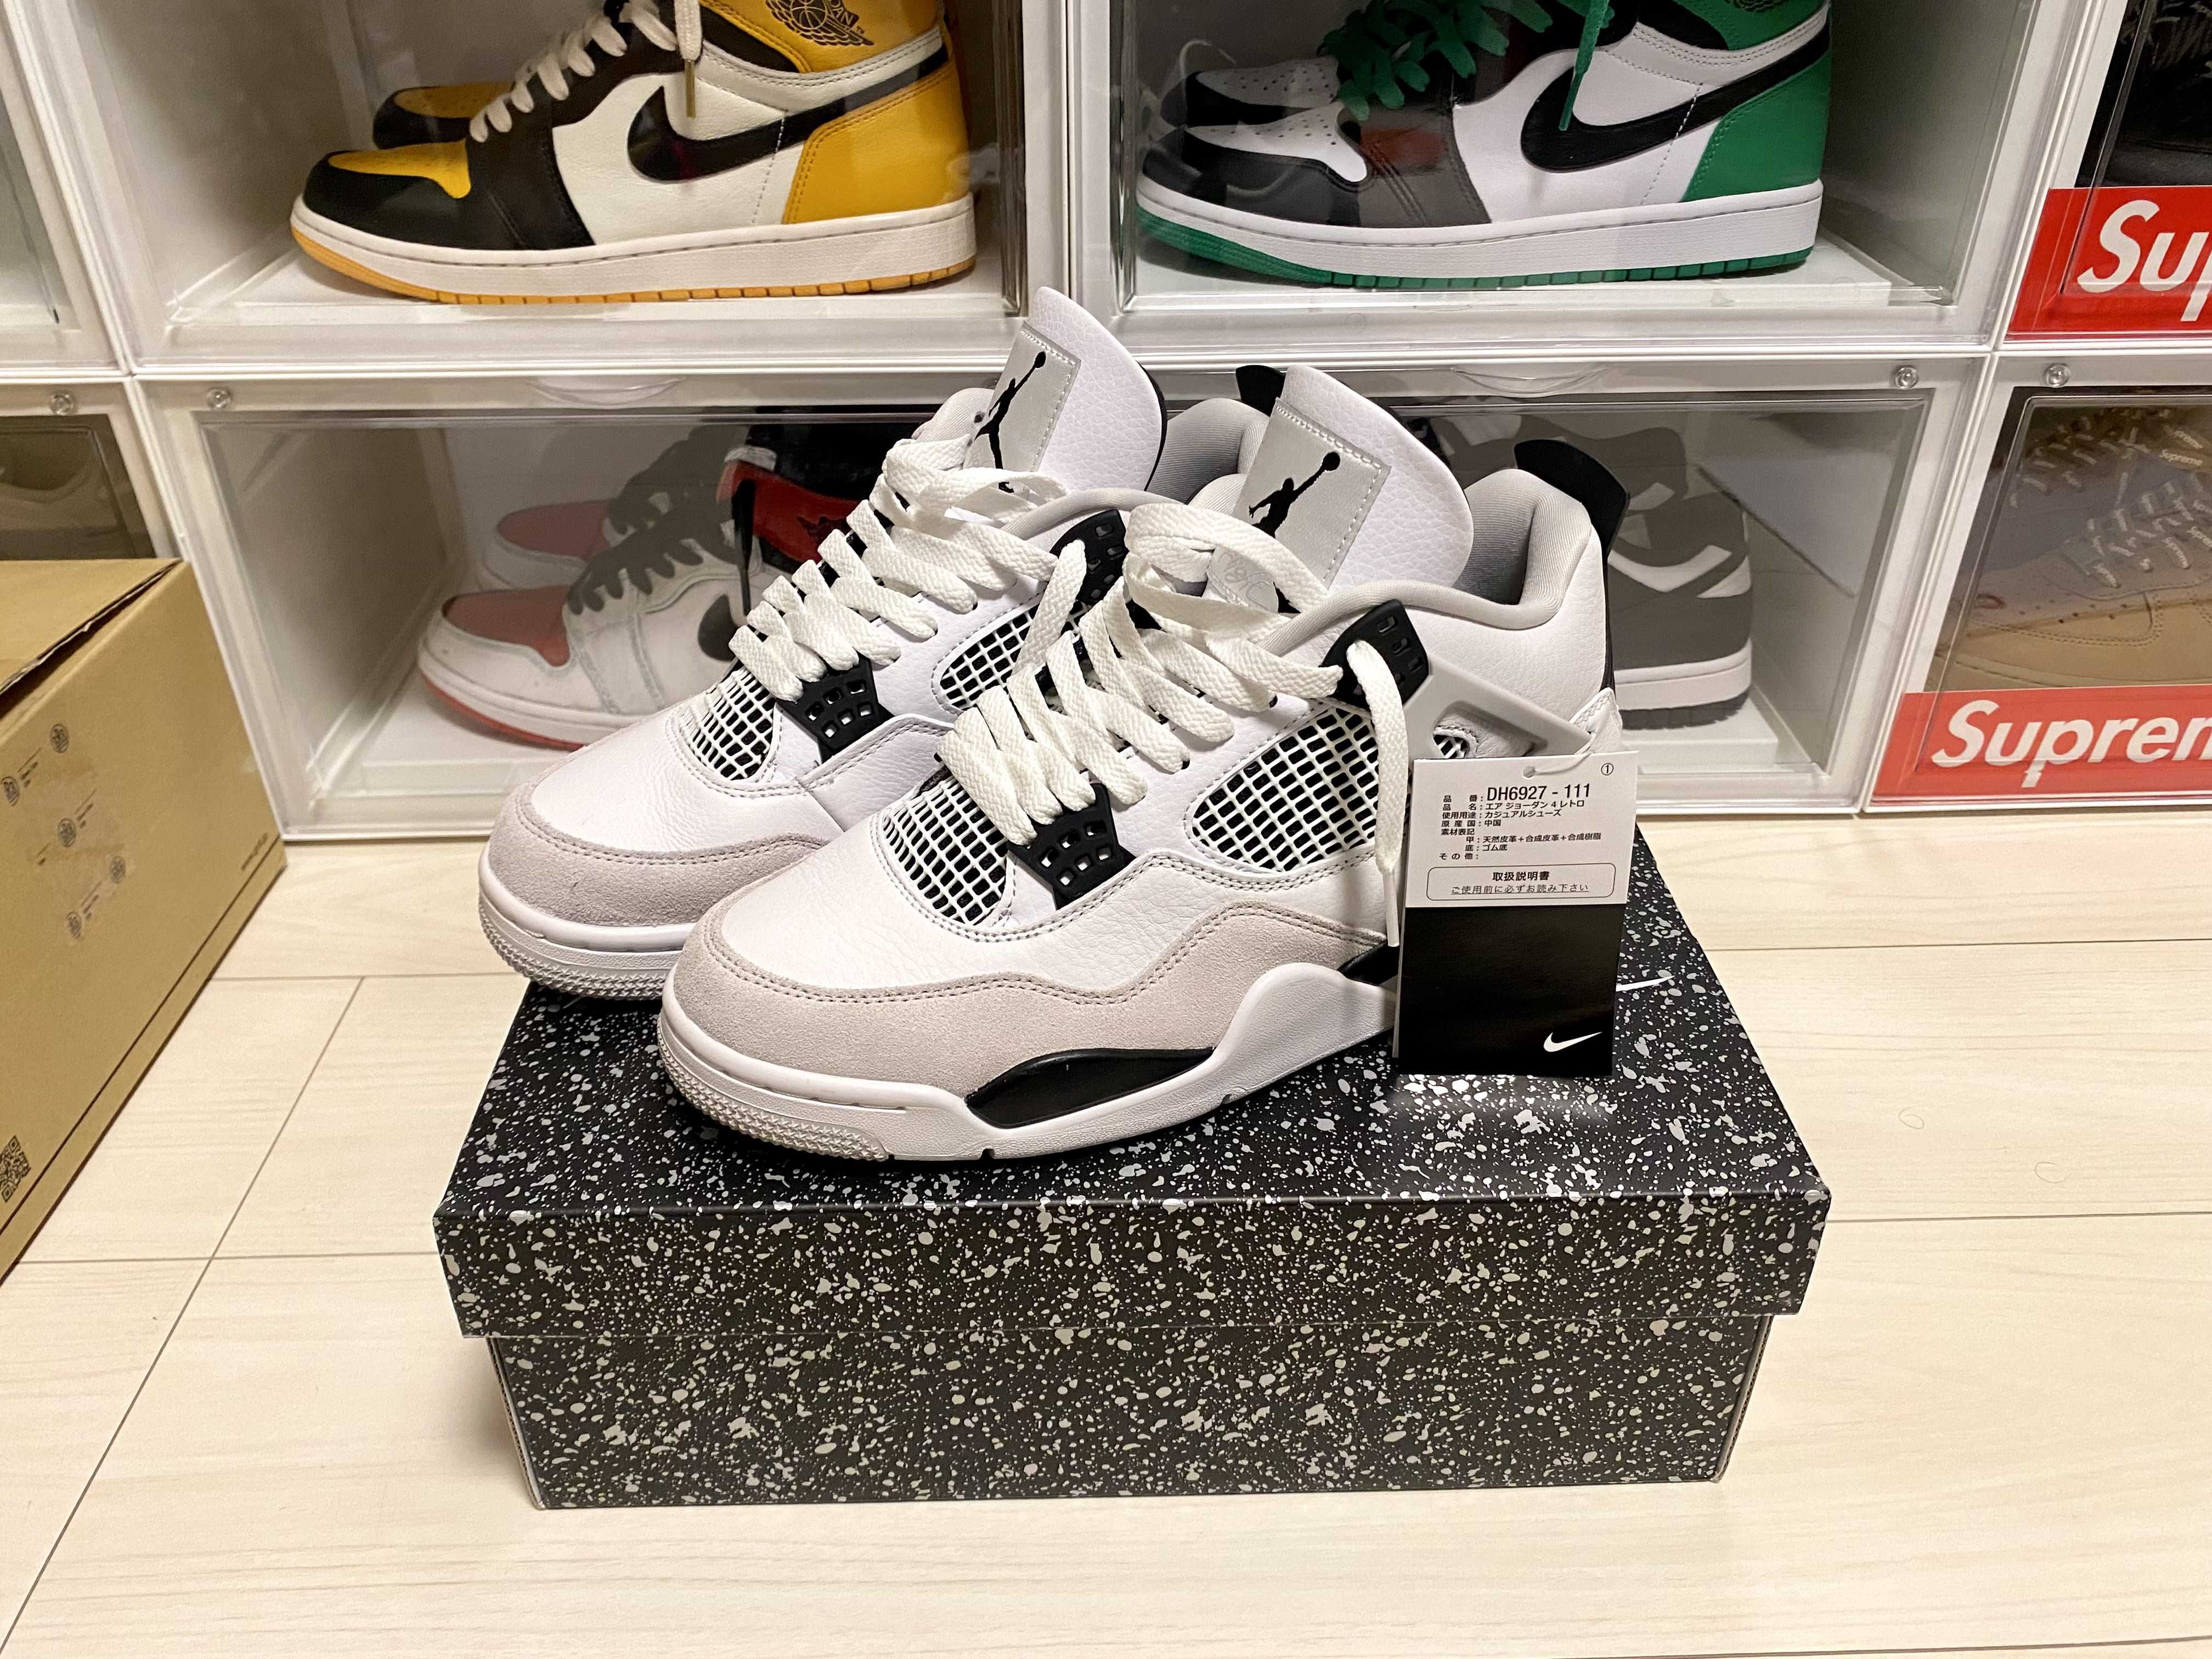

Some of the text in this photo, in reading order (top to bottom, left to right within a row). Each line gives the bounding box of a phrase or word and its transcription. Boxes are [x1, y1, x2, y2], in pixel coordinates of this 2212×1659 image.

[1492, 871, 1550, 882] 取扱説明書
